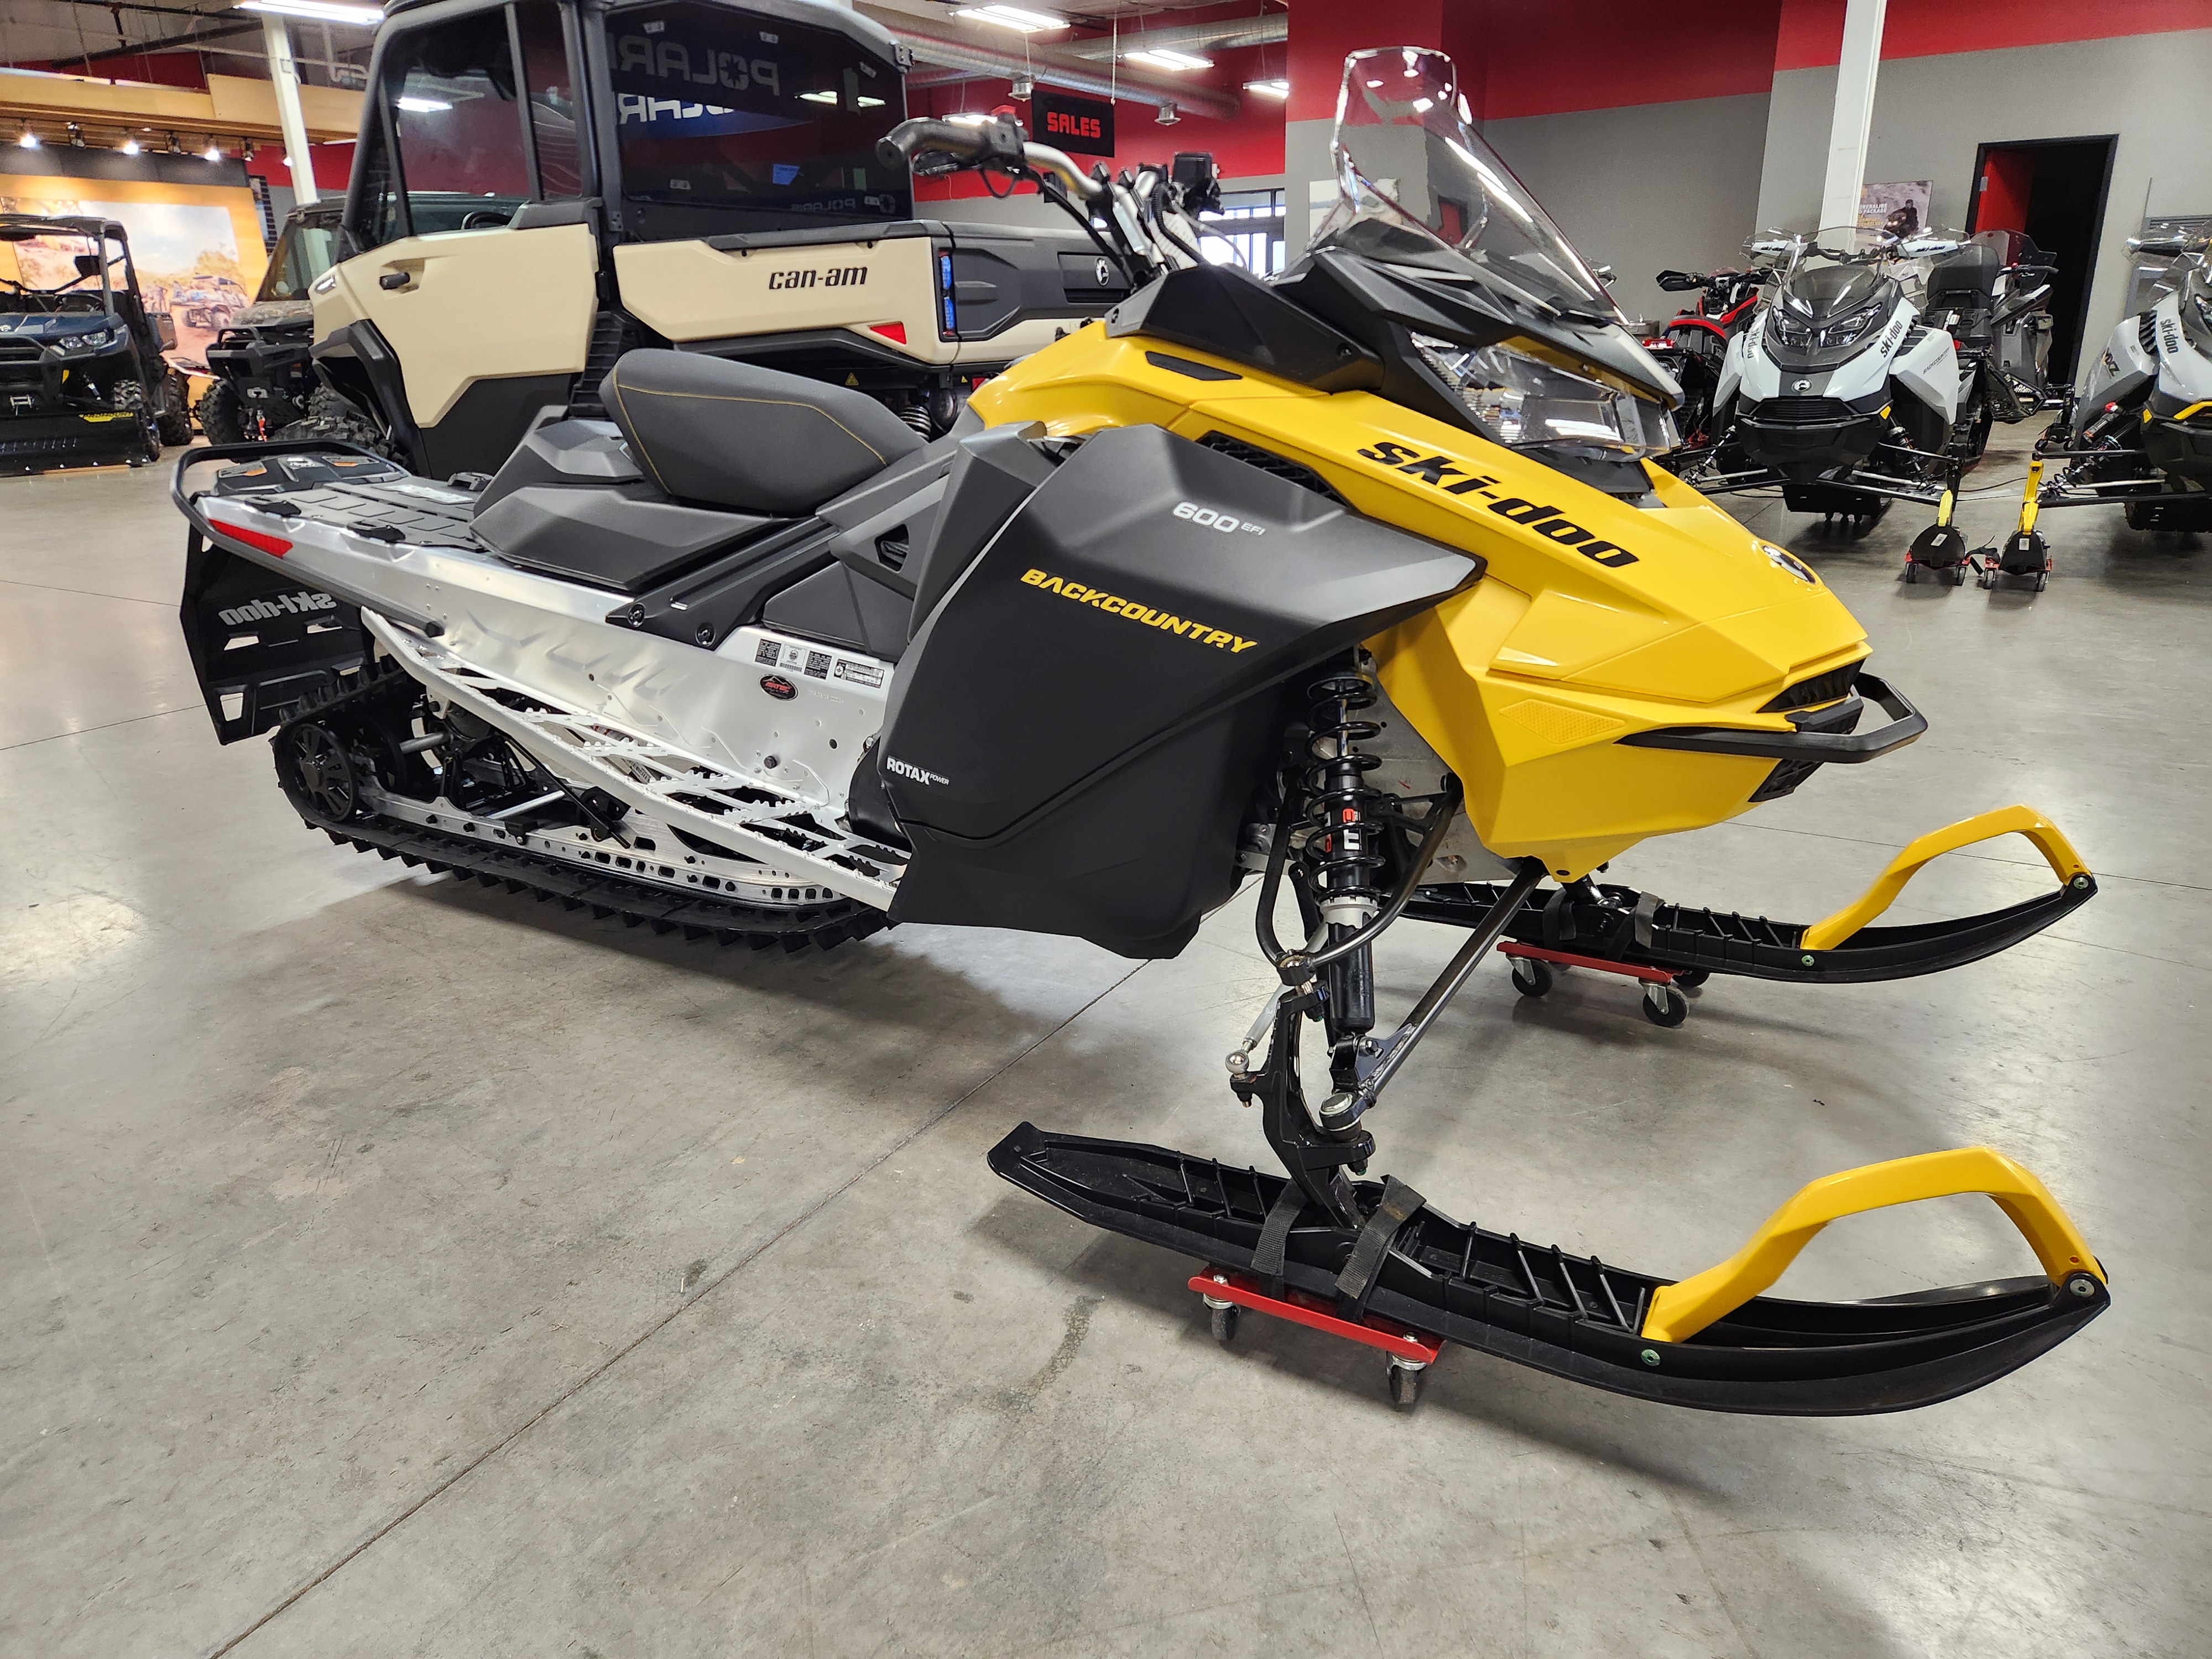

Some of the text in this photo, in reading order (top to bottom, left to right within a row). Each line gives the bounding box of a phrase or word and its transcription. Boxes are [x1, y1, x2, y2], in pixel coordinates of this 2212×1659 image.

[1047, 111, 1101, 139] SALES
[769, 266, 868, 290] can-am
[1880, 320, 1903, 358] ski-doo
[2160, 319, 2179, 354] ski-doo
[1173, 502, 1266, 536] 600 EFI
[1356, 441, 1640, 568] ski-doo
[1020, 568, 1258, 654] BACKCOUNTRY
[886, 757, 950, 786] ROTAX POWER
